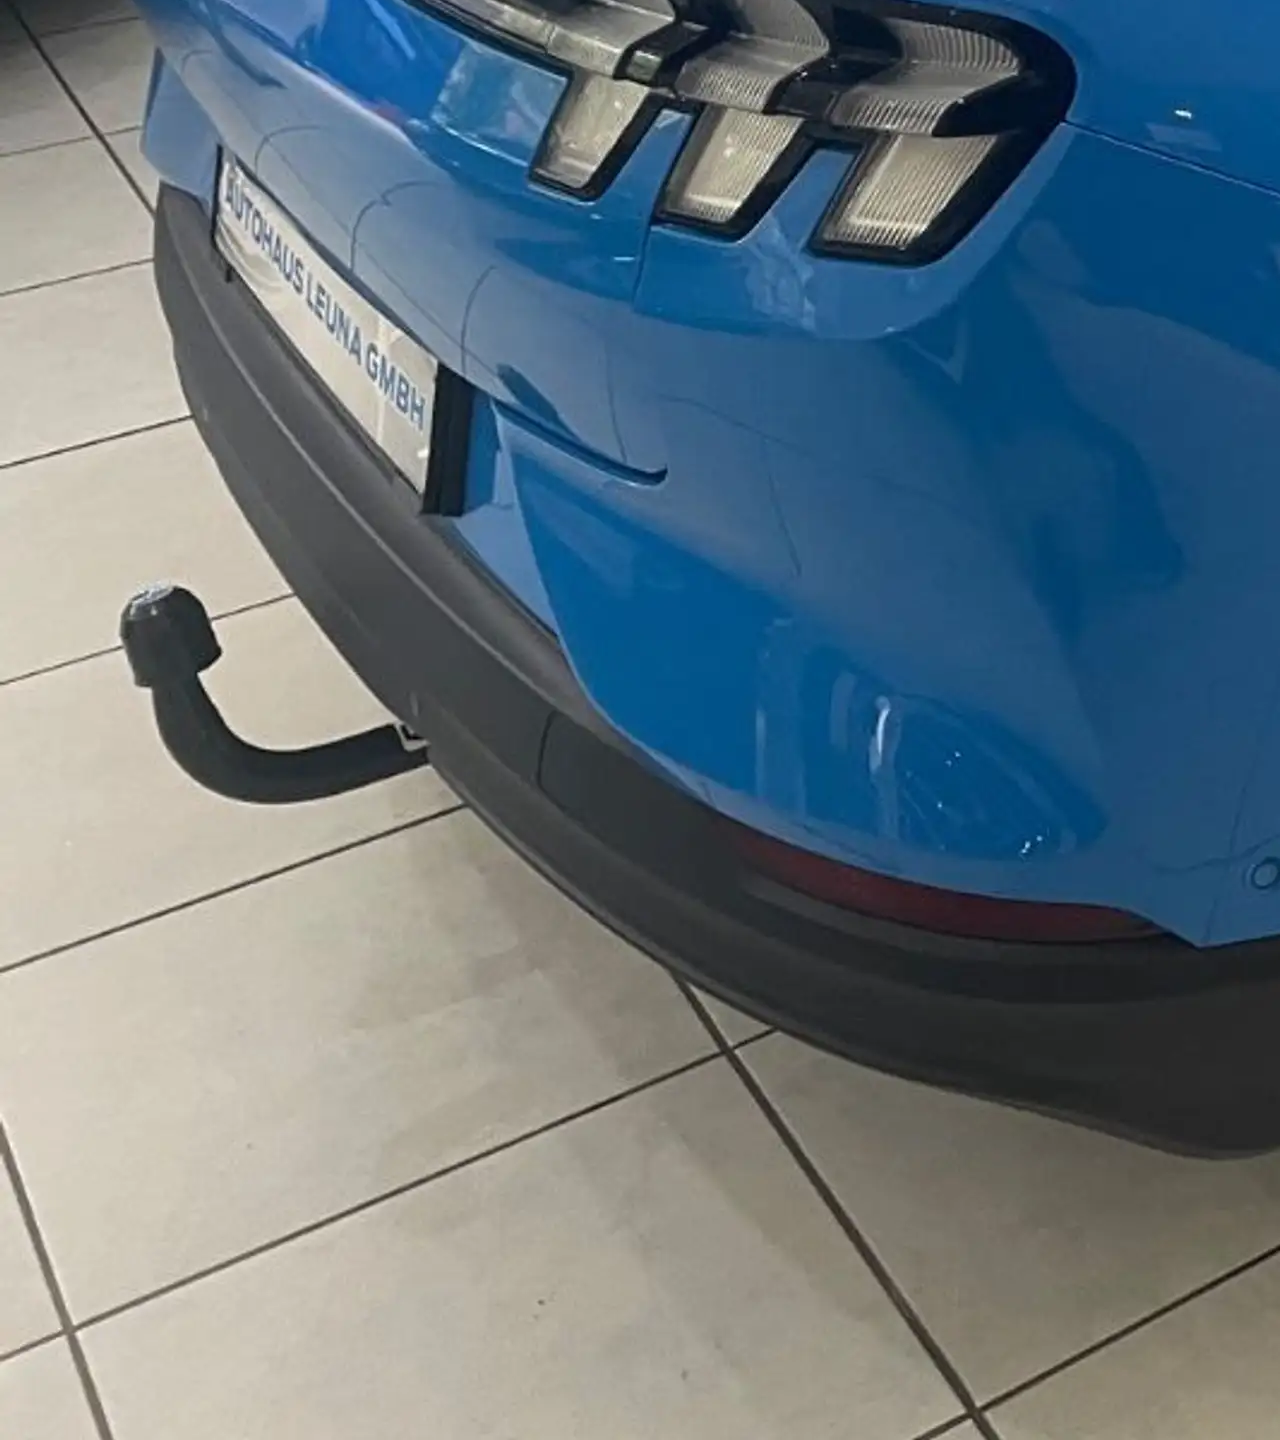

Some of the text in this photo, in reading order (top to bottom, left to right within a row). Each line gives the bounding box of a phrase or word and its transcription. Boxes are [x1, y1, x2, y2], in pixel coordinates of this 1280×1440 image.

[223, 162, 426, 431] AUTOHAUS LEUNA GMBH
